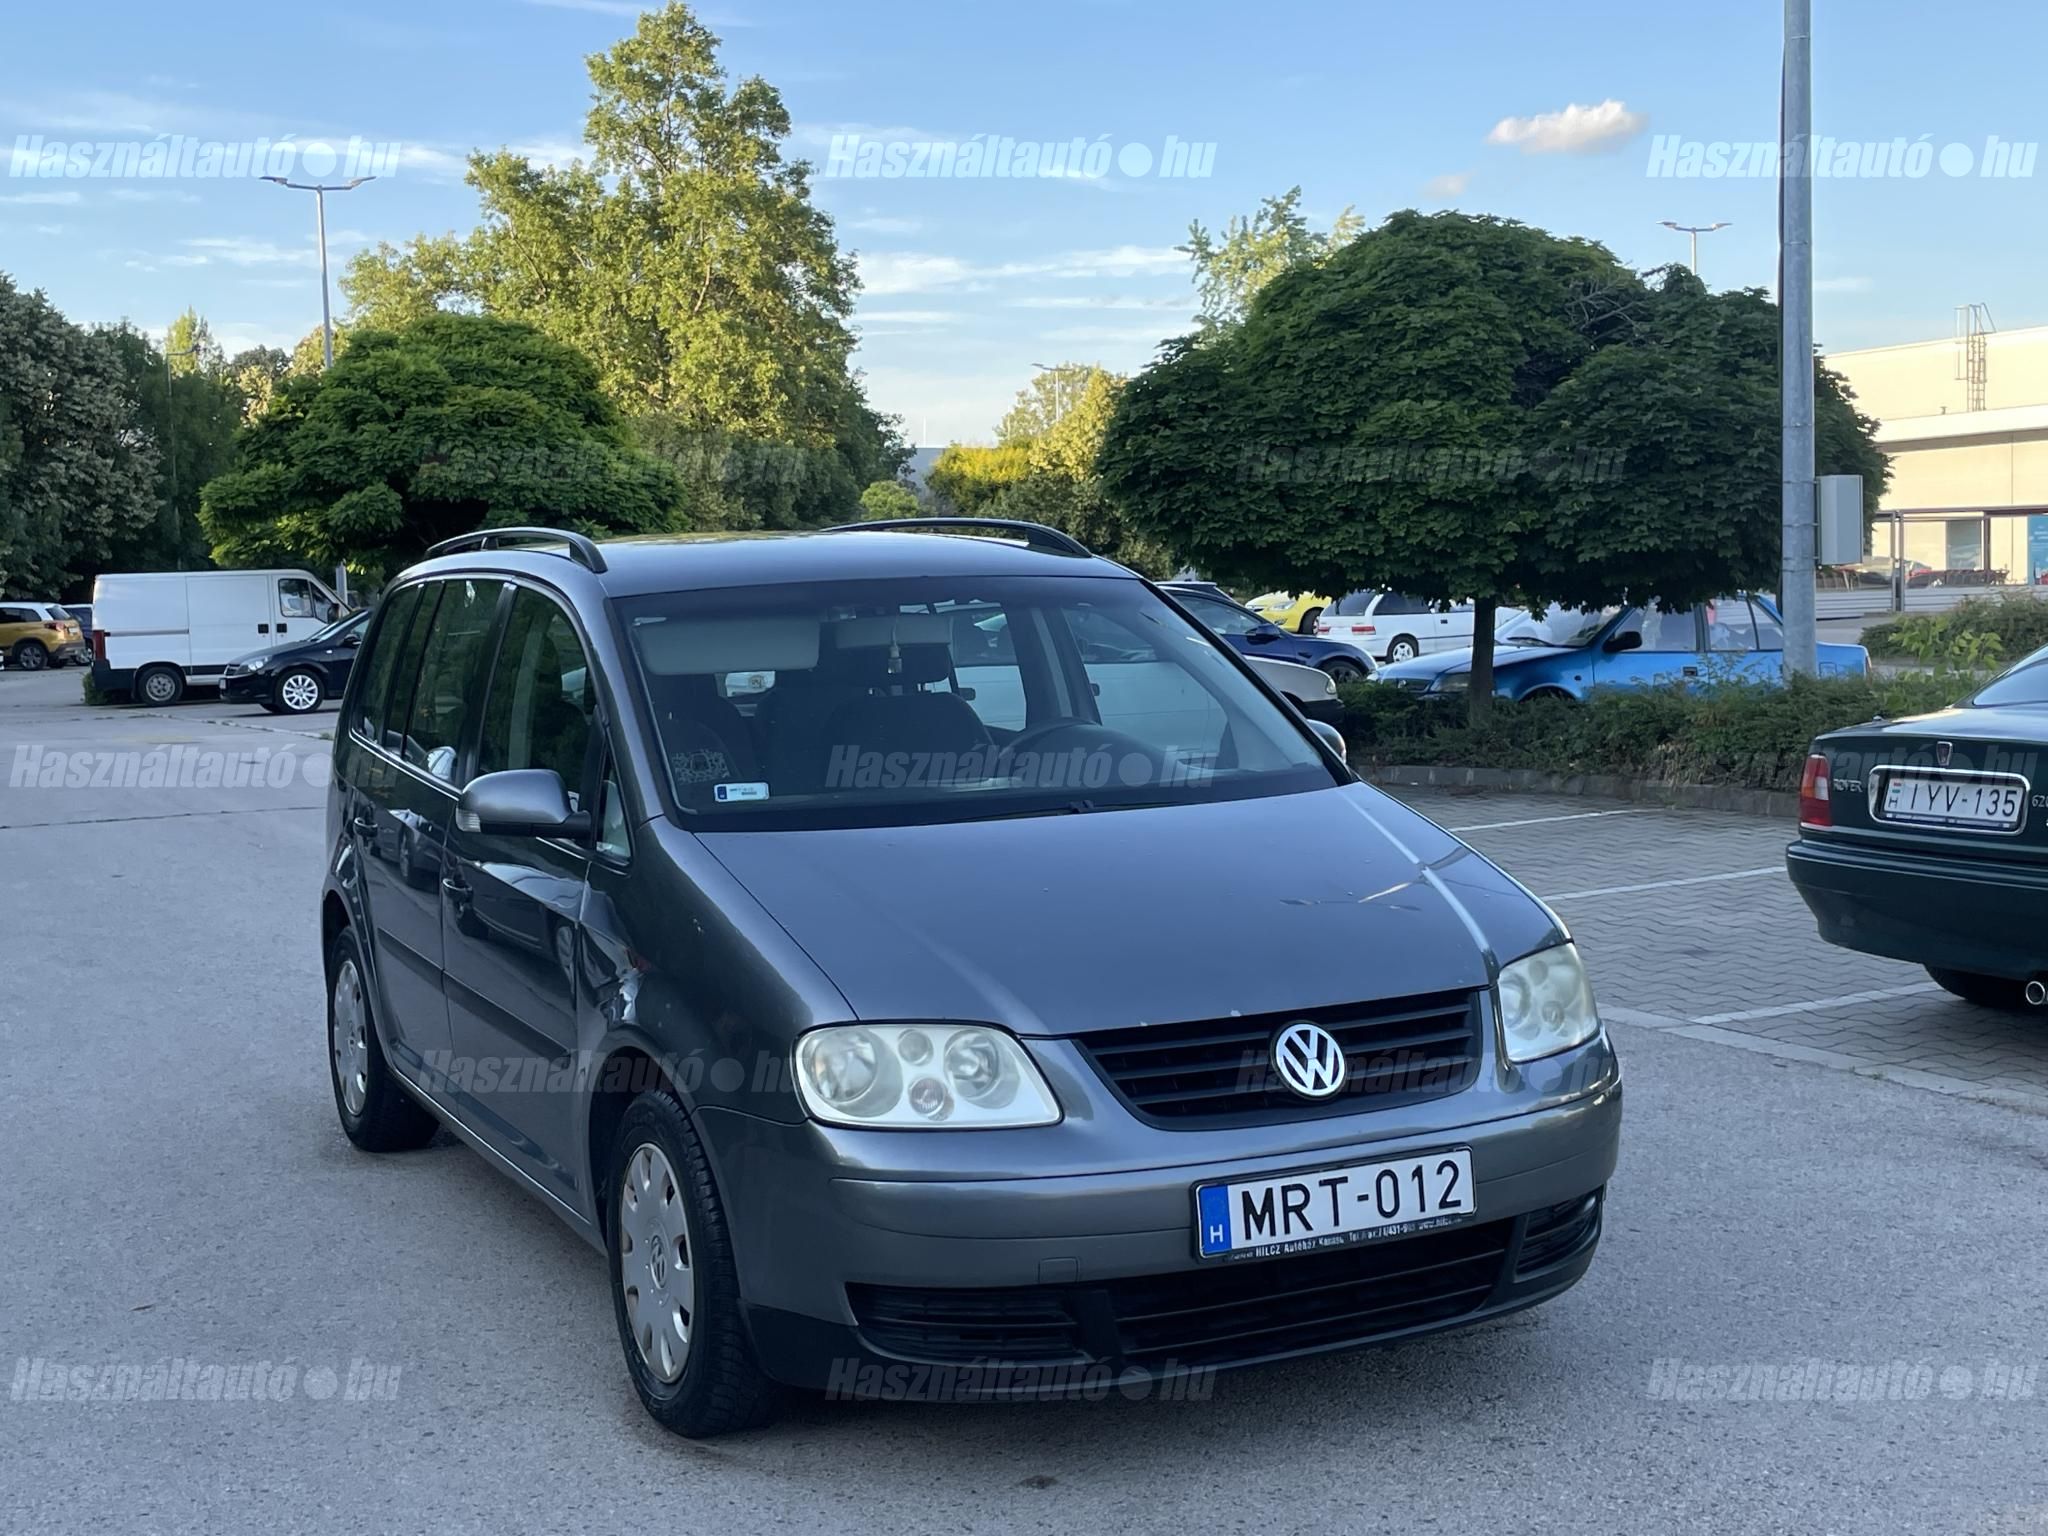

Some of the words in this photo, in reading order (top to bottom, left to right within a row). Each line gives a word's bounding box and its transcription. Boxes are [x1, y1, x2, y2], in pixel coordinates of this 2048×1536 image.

[1911, 783, 2018, 817] IYV-135
[1209, 1223, 1224, 1244] H
[1240, 1159, 1463, 1241] MRT-012
